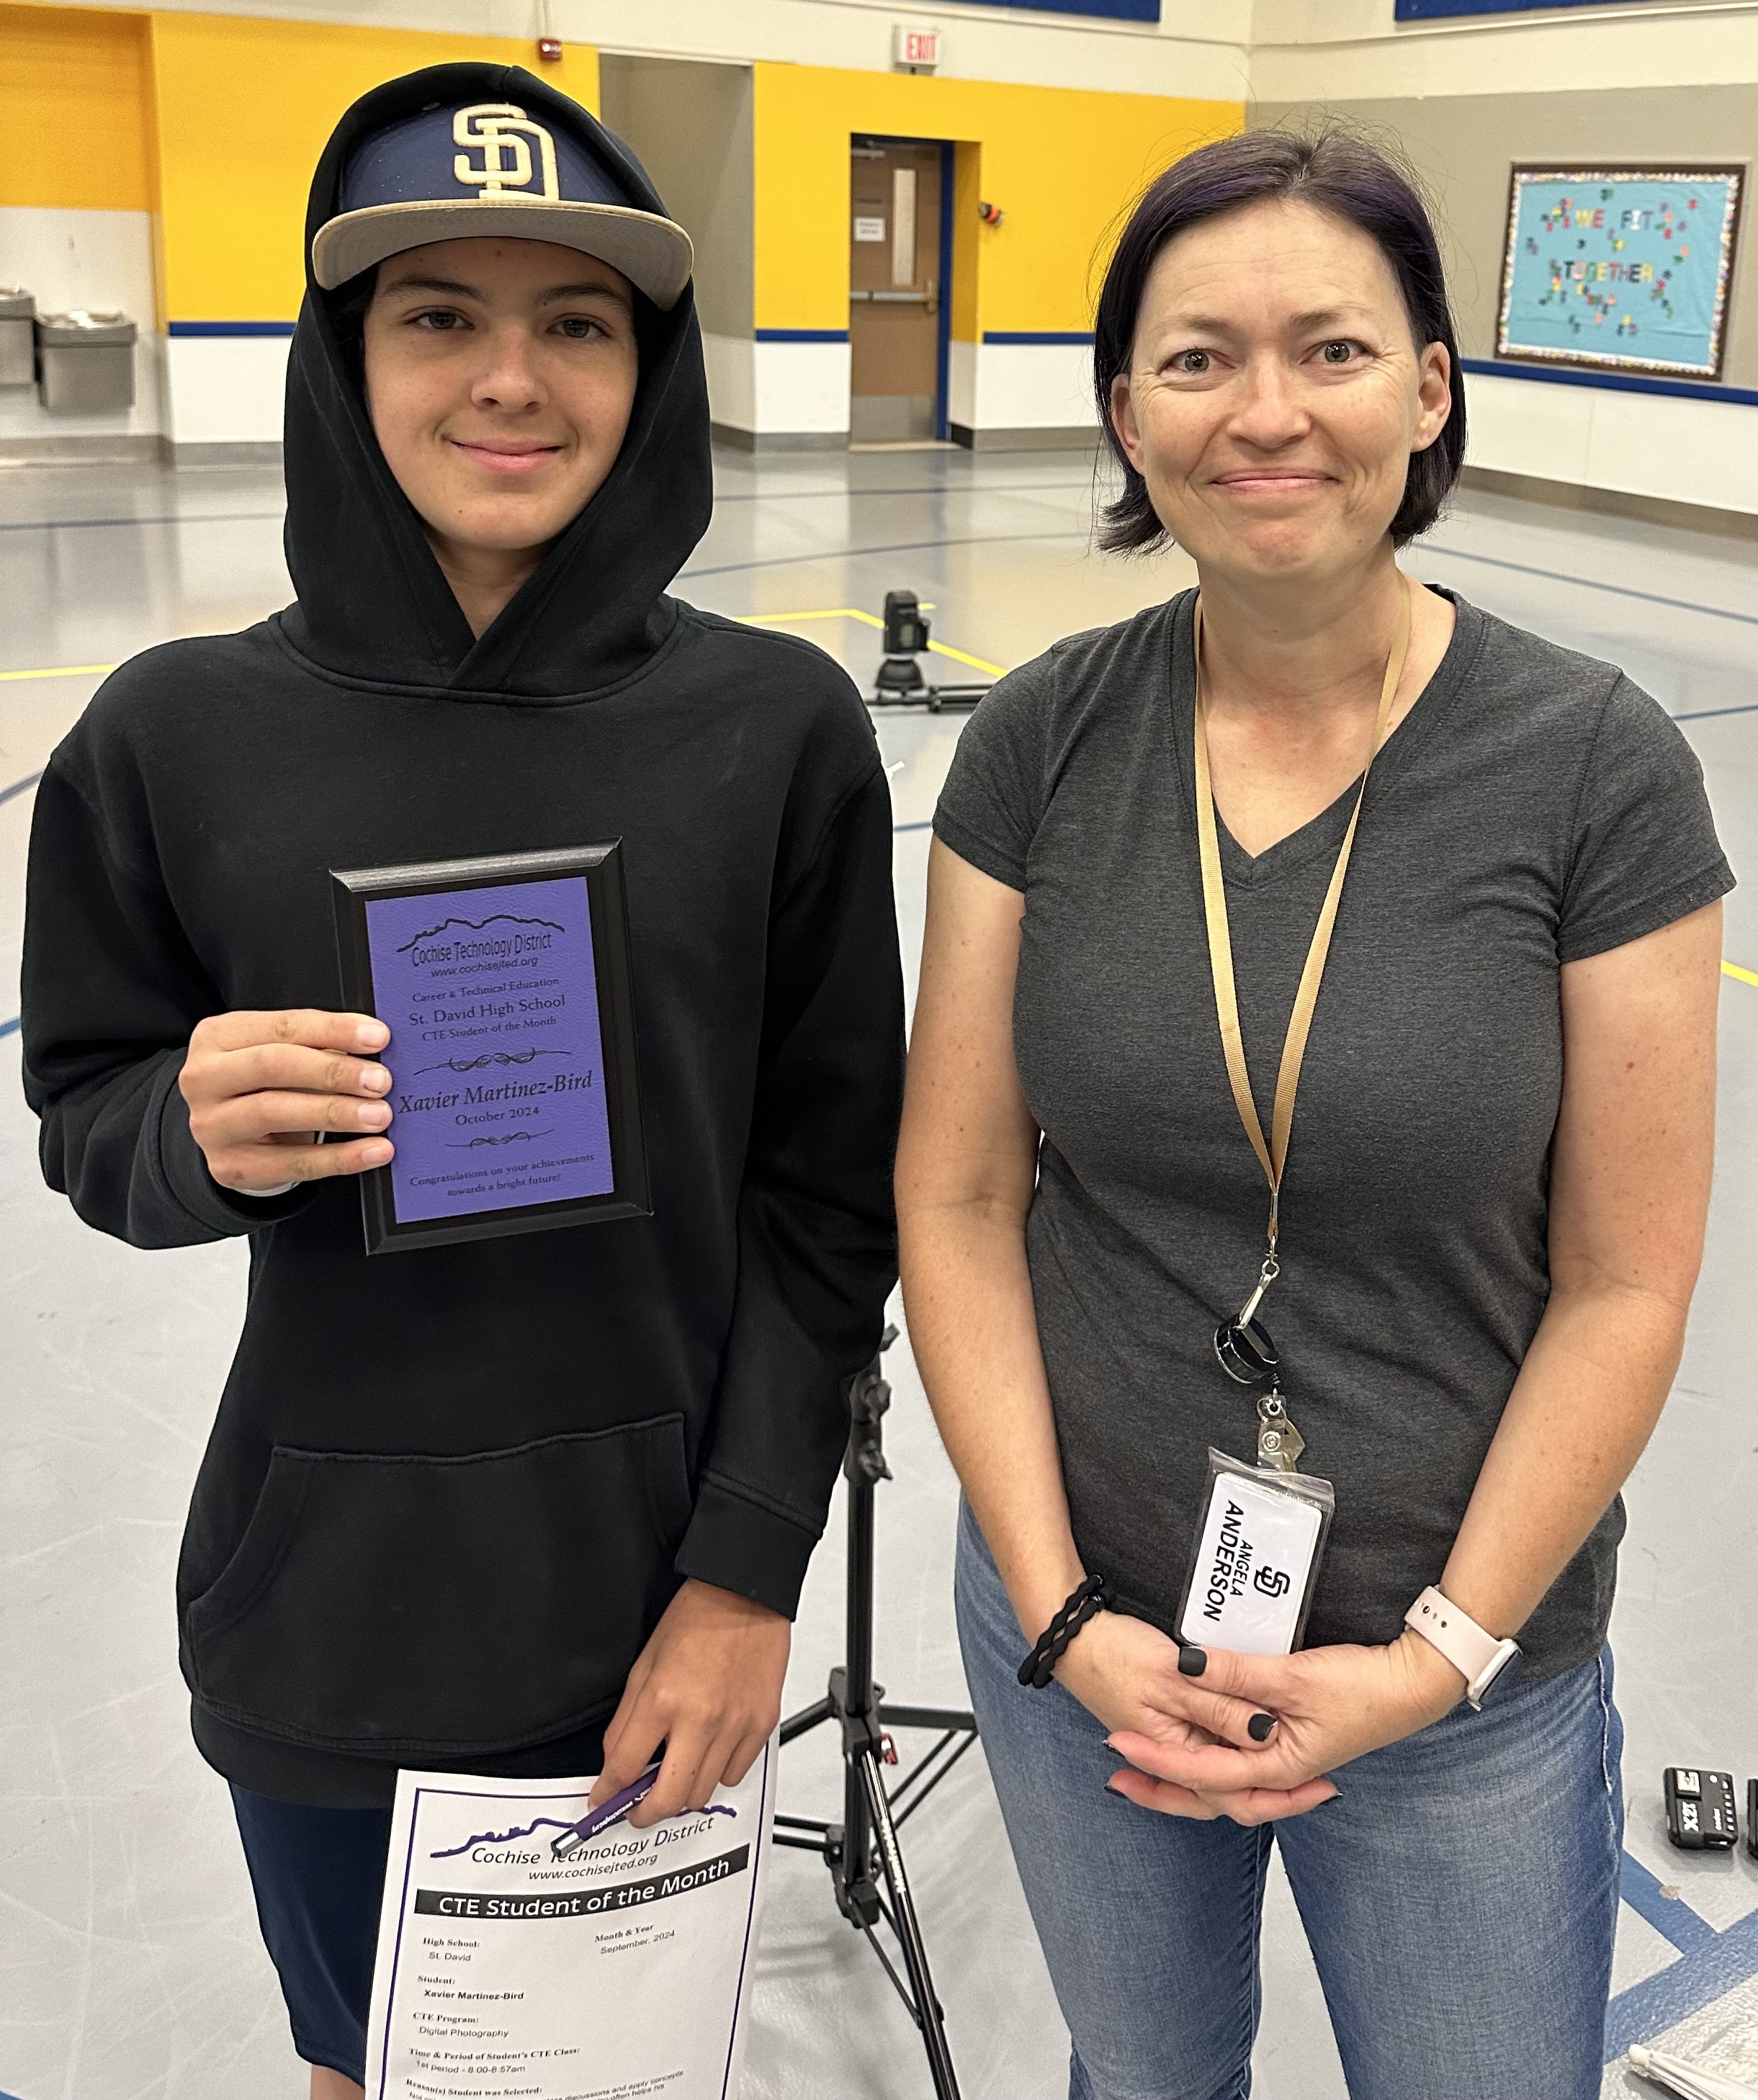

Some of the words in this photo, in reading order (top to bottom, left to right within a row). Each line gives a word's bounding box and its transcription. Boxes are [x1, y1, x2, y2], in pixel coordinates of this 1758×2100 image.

[907, 33, 937, 61] EXIT
[453, 103, 560, 200] SD
[1575, 209, 1605, 228] WE
[1620, 209, 1654, 231] FIT
[1564, 260, 1654, 283] TOGETHER
[412, 944, 452, 967] Cochise
[454, 937, 512, 962] Technology
[515, 931, 552, 953] District
[431, 956, 539, 977] www.cochisejted.org
[412, 992, 446, 1003] Career
[459, 982, 506, 997] Technical
[508, 977, 560, 991] Education
[409, 1013, 428, 1026] St.
[434, 1009, 475, 1023] David
[480, 1002, 514, 1018] High
[519, 995, 566, 1012] School
[422, 1030, 446, 1041] CTE
[449, 1026, 489, 1038] Student
[491, 1022, 503, 1032] of
[505, 1020, 521, 1031] the
[524, 1017, 557, 1028] Month
[398, 1091, 459, 1113] Xavier
[464, 1070, 593, 1105] Martinez-Bird
[455, 1112, 505, 1126] October
[510, 1106, 539, 1118] 2024
[410, 1170, 488, 1187] Congratulations
[506, 1162, 529, 1175] your
[531, 1154, 595, 1170] achievements
[447, 1183, 486, 1197] towards
[496, 1177, 526, 1190] bright
[529, 1173, 561, 1185] future!
[1203, 1499, 1244, 1622] ANDERSON
[1229, 1538, 1254, 1597] ANGELA
[472, 1847, 541, 1865] Cochise
[654, 1816, 715, 1848] District
[529, 1853, 658, 1881] www.cochisejted.org
[439, 1896, 480, 1916] CTE
[486, 1898, 580, 1916] Student
[587, 1891, 613, 1911] of
[618, 1885, 655, 1907] the
[662, 1859, 730, 1894] Month
[423, 1937, 444, 1947] High
[447, 1939, 480, 1948] School:
[594, 1930, 624, 1943] Month
[635, 1924, 654, 1934] Year
[653, 1929, 676, 1942] 2024
[444, 1952, 471, 1962] David
[417, 1975, 456, 1985] Student:
[423, 1989, 455, 1999] Xavier
[457, 1991, 524, 2001] Martinez-Bird
[413, 2011, 434, 2021] CTE
[436, 2014, 480, 2024] Program:
[418, 2026, 448, 2037] Digital
[450, 2028, 510, 2039] Photography
[409, 2047, 431, 2059] Time
[486, 2052, 528, 2060] Student's
[530, 2050, 551, 2058] CTE
[431, 2063, 460, 2073] period
[406, 2078, 446, 2095] Reason(s)
